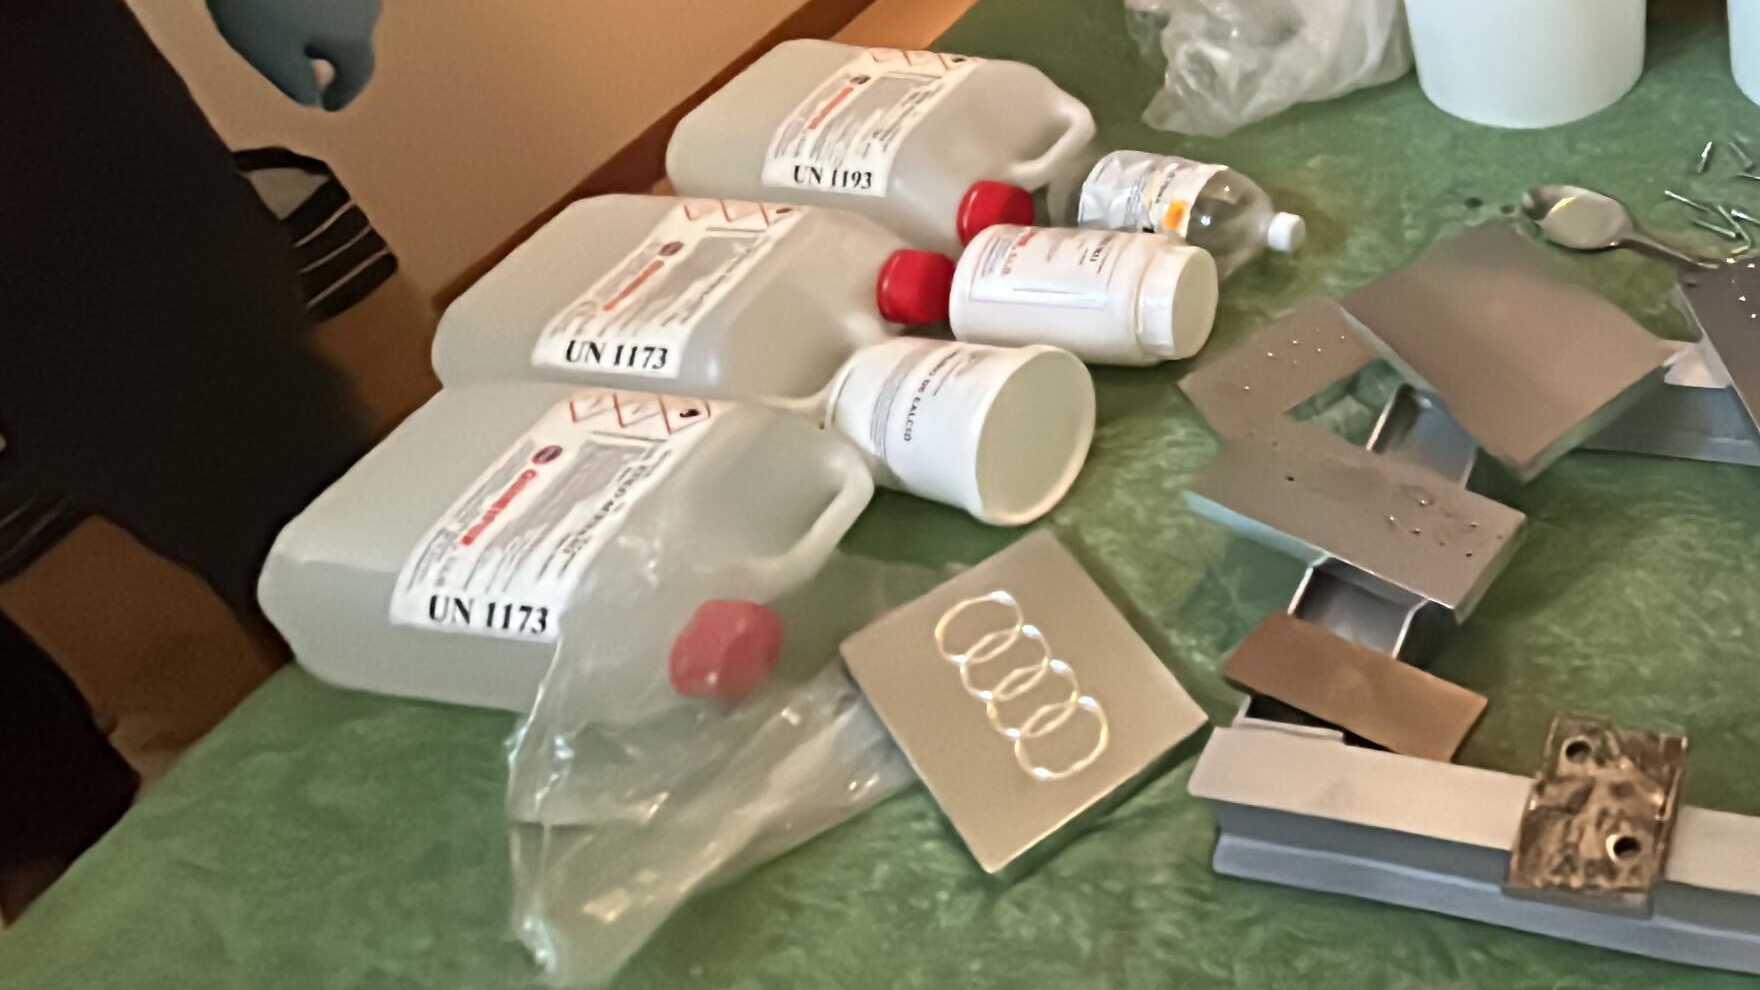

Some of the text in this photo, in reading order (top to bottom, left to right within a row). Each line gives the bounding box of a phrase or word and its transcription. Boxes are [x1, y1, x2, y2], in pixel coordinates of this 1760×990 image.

[793, 165, 873, 189] UN 1193
[565, 339, 668, 370] UN 1173
[429, 594, 549, 635] UN 1173
